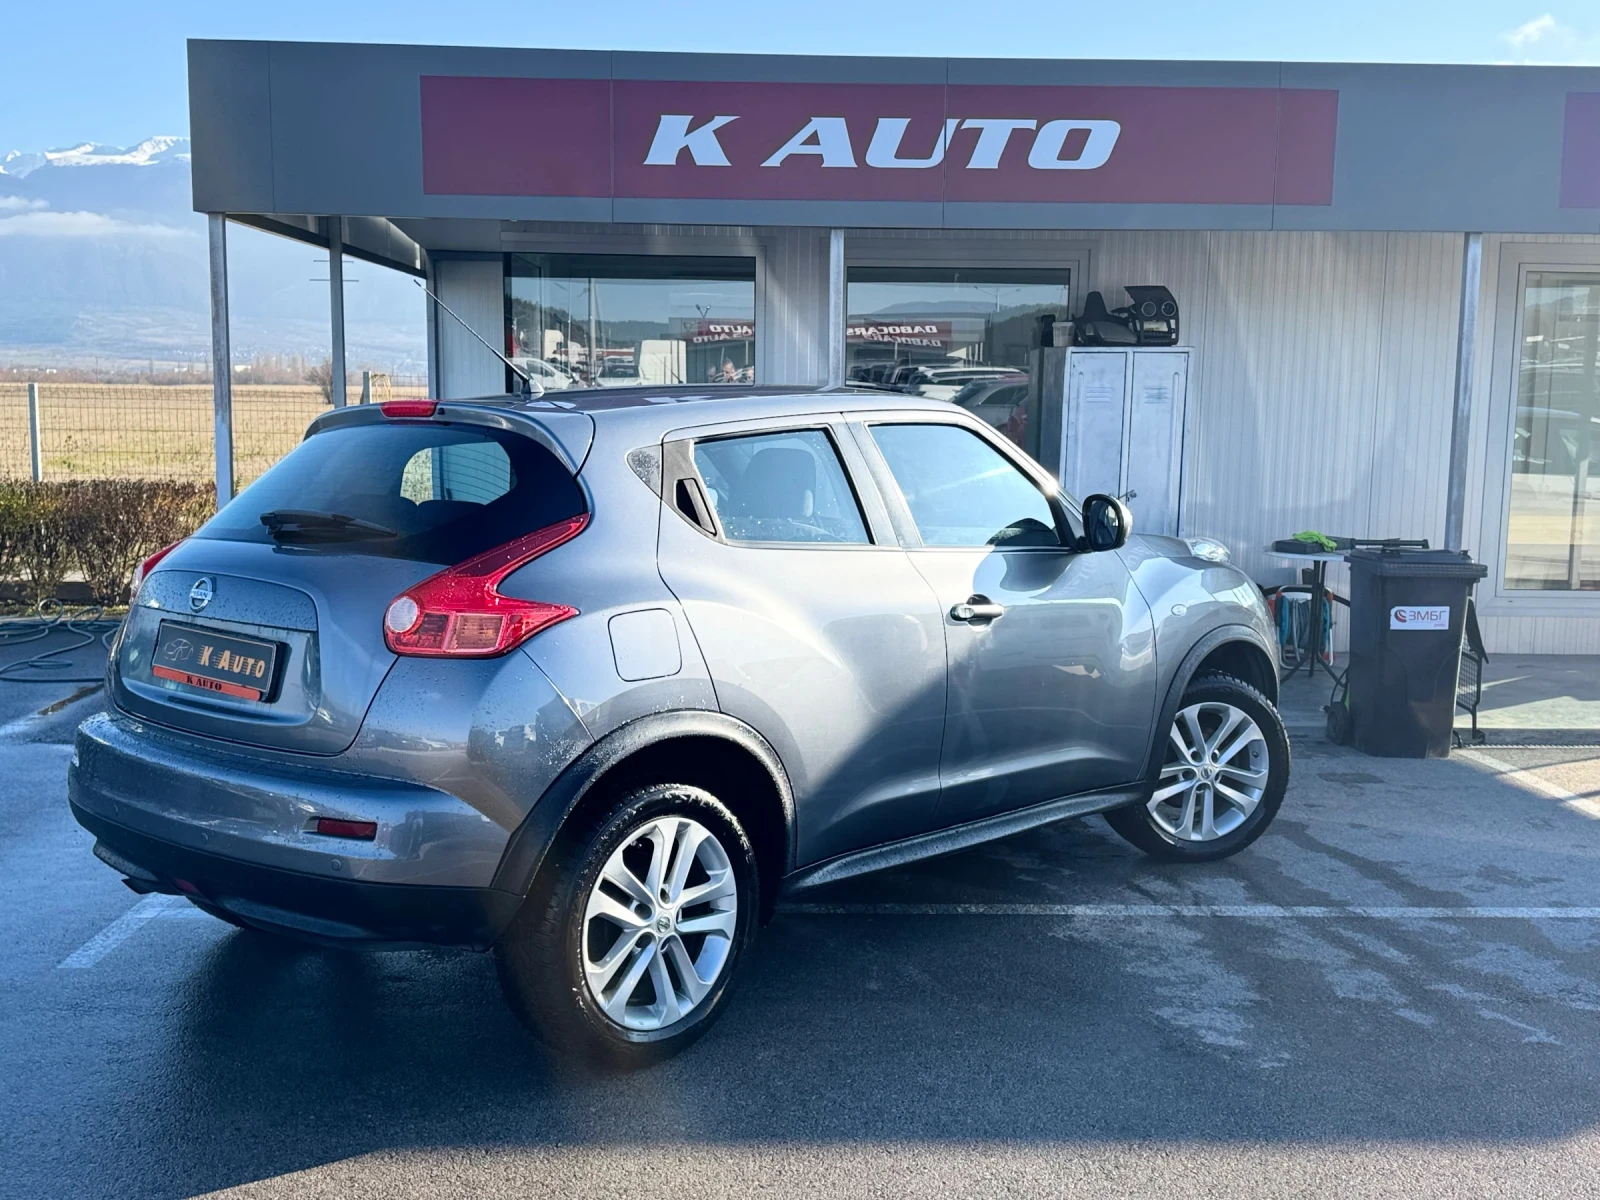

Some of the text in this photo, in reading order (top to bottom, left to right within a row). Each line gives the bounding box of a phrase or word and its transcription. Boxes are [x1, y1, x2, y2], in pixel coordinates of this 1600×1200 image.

[642, 114, 1122, 170] K AUTO
[1408, 610, 1447, 621] ЗМБГ
[199, 645, 266, 678] K AUTO
[186, 675, 222, 691] K AUTO
